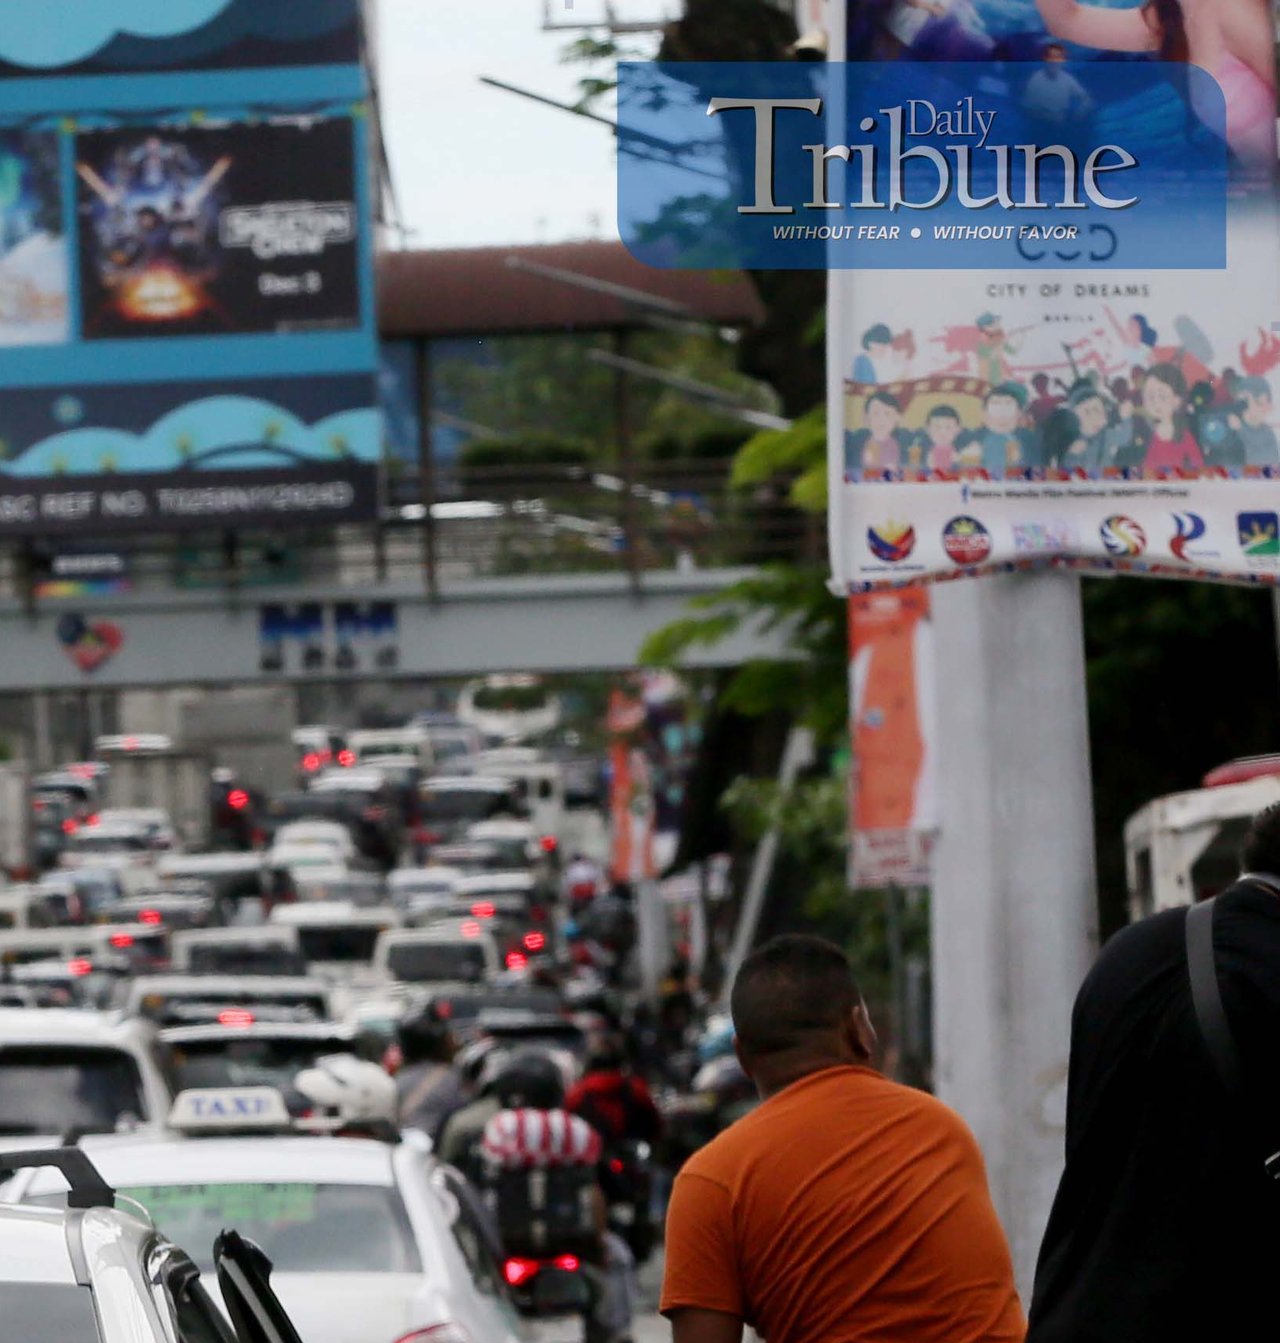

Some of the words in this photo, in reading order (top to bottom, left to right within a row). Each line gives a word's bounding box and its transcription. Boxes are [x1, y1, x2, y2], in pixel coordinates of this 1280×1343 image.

[986, 284, 1027, 298] CITY
[1040, 284, 1061, 298] OF
[1074, 284, 1150, 298] DREAMS
